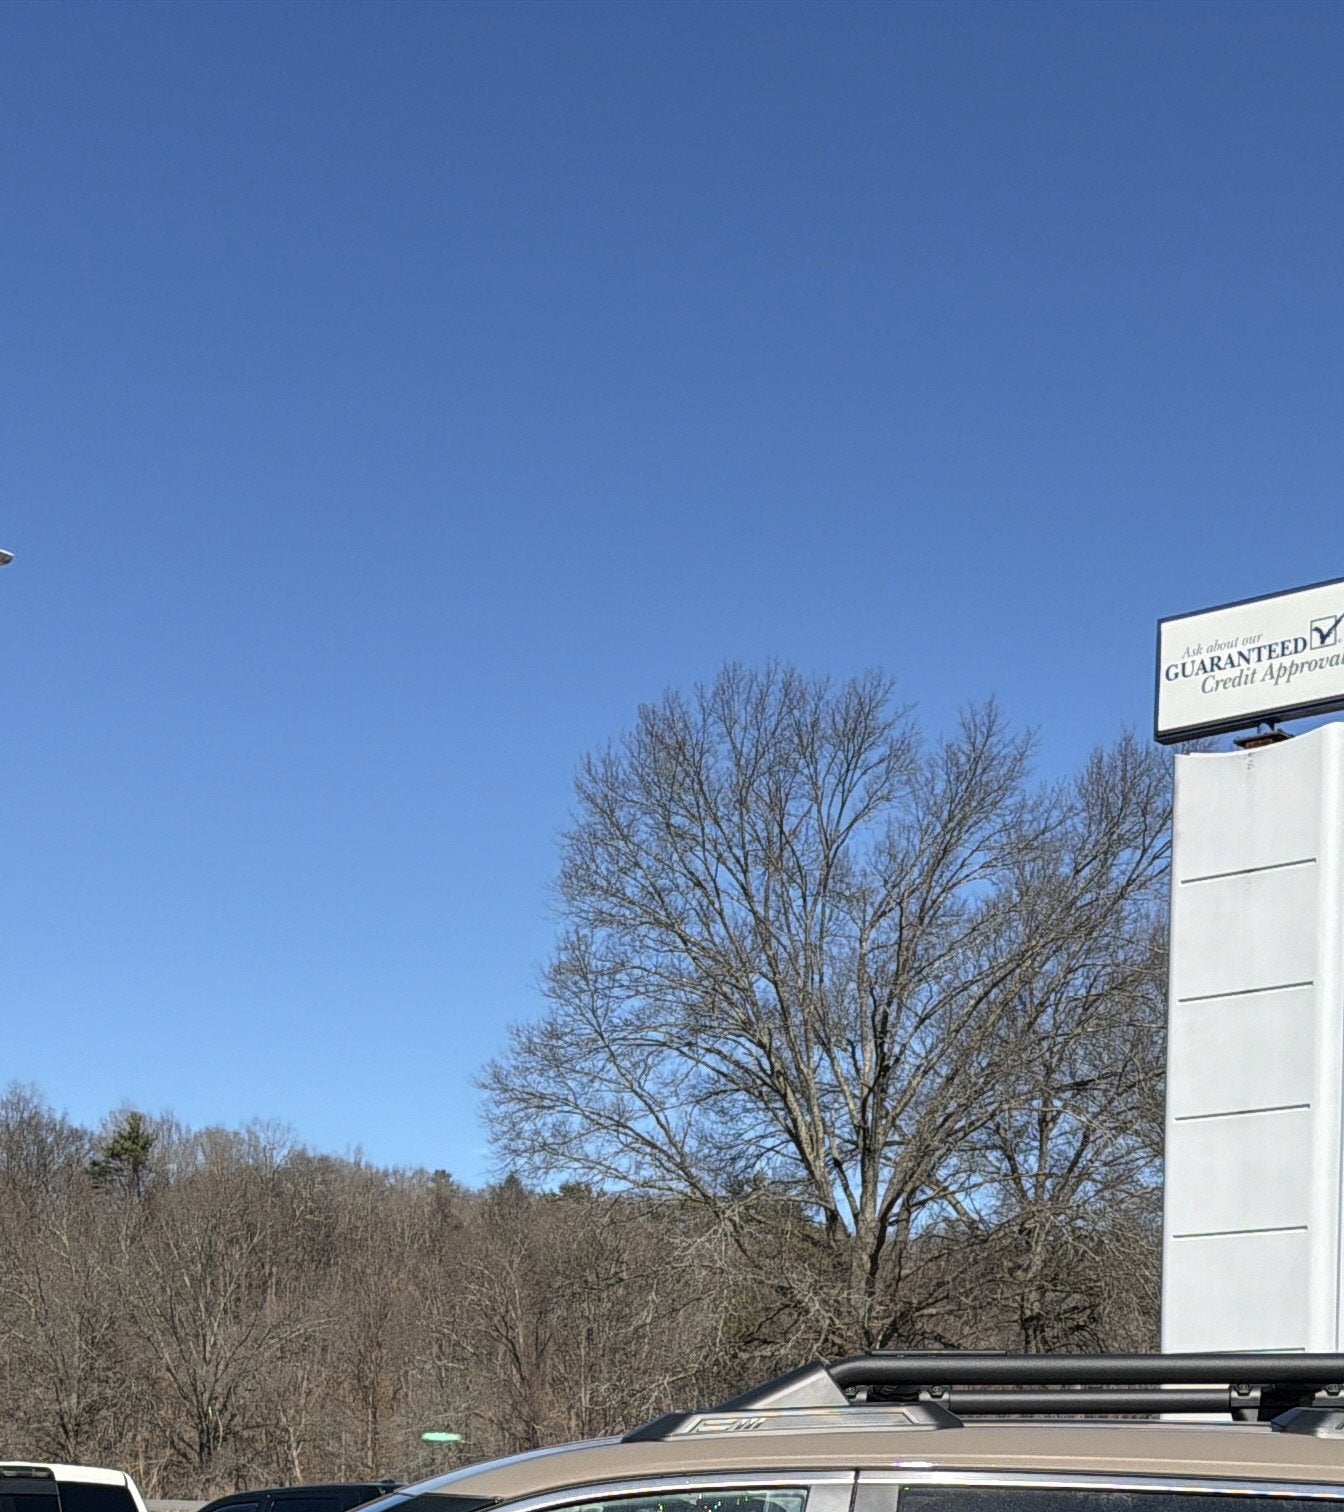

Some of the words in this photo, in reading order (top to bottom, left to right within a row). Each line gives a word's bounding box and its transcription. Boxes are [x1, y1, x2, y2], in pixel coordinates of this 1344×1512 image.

[1165, 636, 1307, 681] GUARANTEED
[1182, 642, 1202, 659] Ask
[1206, 638, 1239, 652] about
[1242, 632, 1263, 646] our
[1201, 669, 1257, 694] Credit
